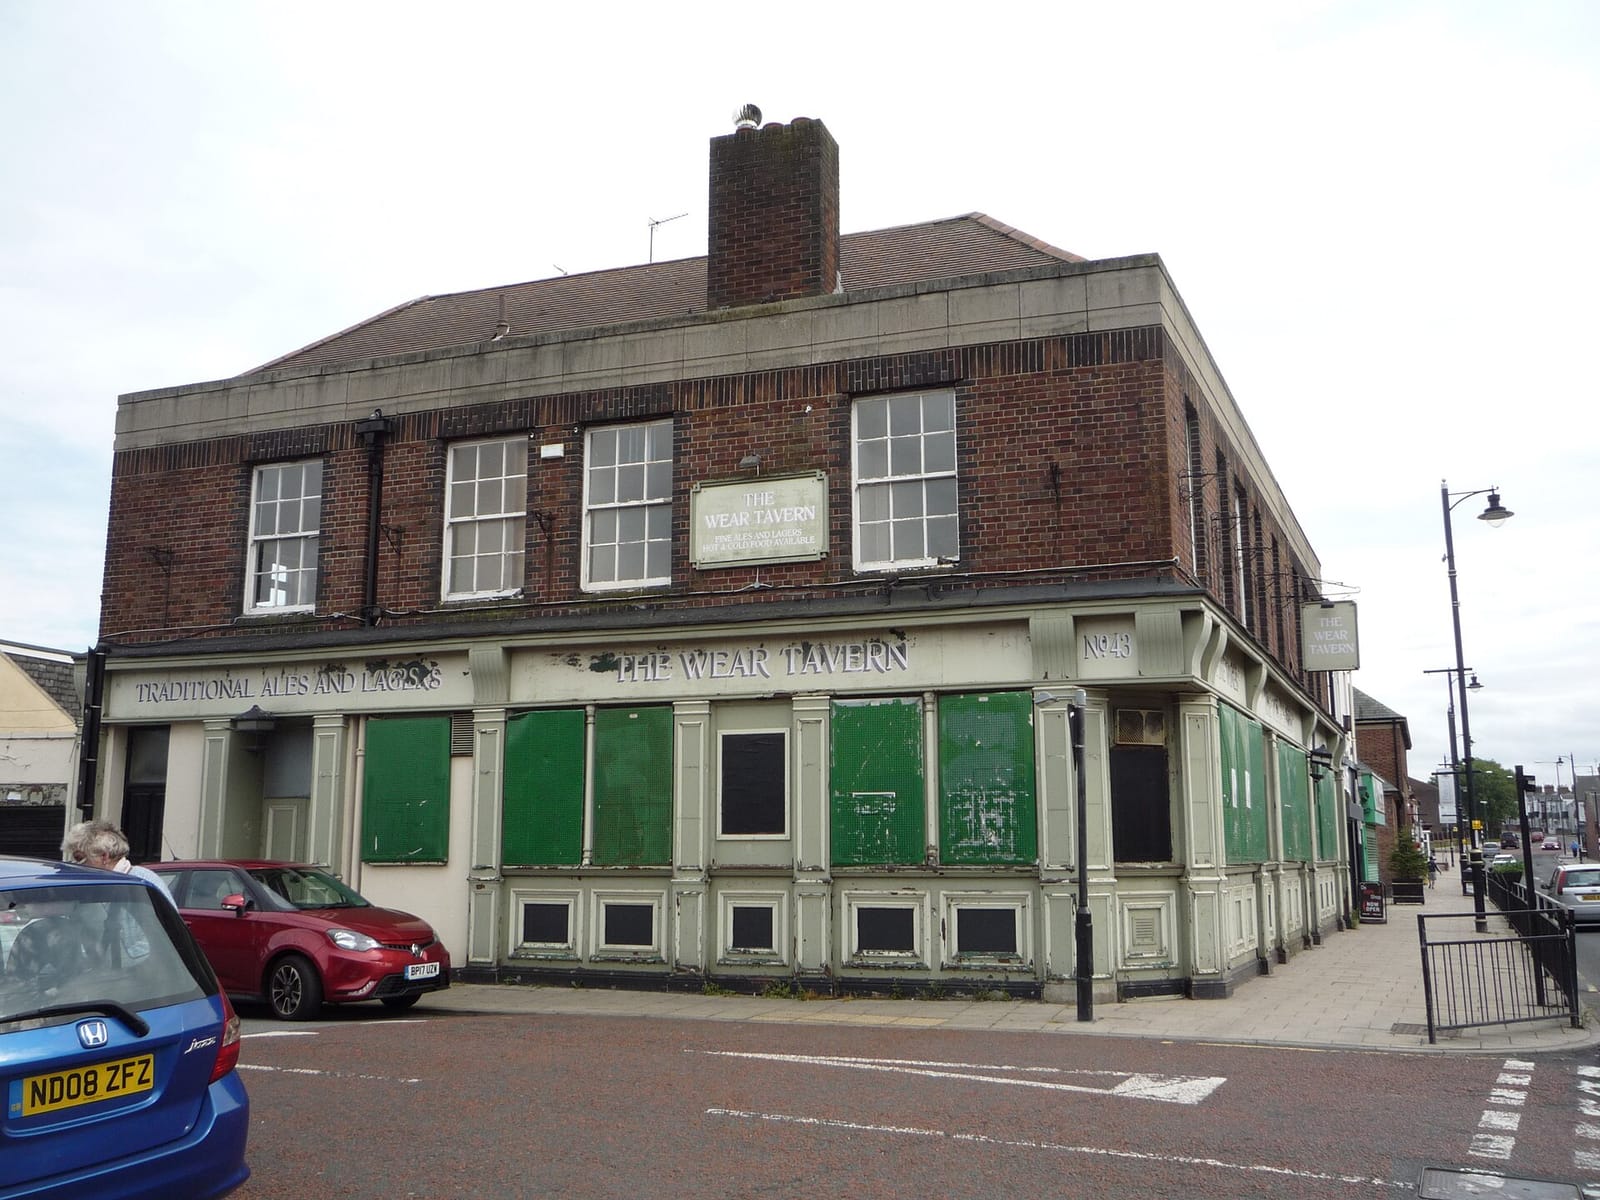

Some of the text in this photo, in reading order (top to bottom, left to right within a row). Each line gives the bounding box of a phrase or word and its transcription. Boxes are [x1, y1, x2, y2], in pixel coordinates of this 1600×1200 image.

[744, 492, 774, 506] THE
[705, 505, 815, 528] WEAR TAVERN
[755, 531, 770, 539] AND
[772, 528, 802, 538] LAGERS
[703, 543, 719, 552] HOT
[728, 541, 749, 550] COLD
[775, 535, 816, 546] AVAILABLE
[1320, 617, 1342, 627] THE
[1313, 630, 1348, 640] WEAR
[1310, 643, 1355, 654] TAVERN
[615, 641, 909, 683] THE WEAR TAVERN
[135, 677, 256, 703] TRADITIONAL
[261, 673, 309, 698] ALES
[313, 670, 356, 695] AND
[31, 1058, 150, 1107] ND08 ZFZ
